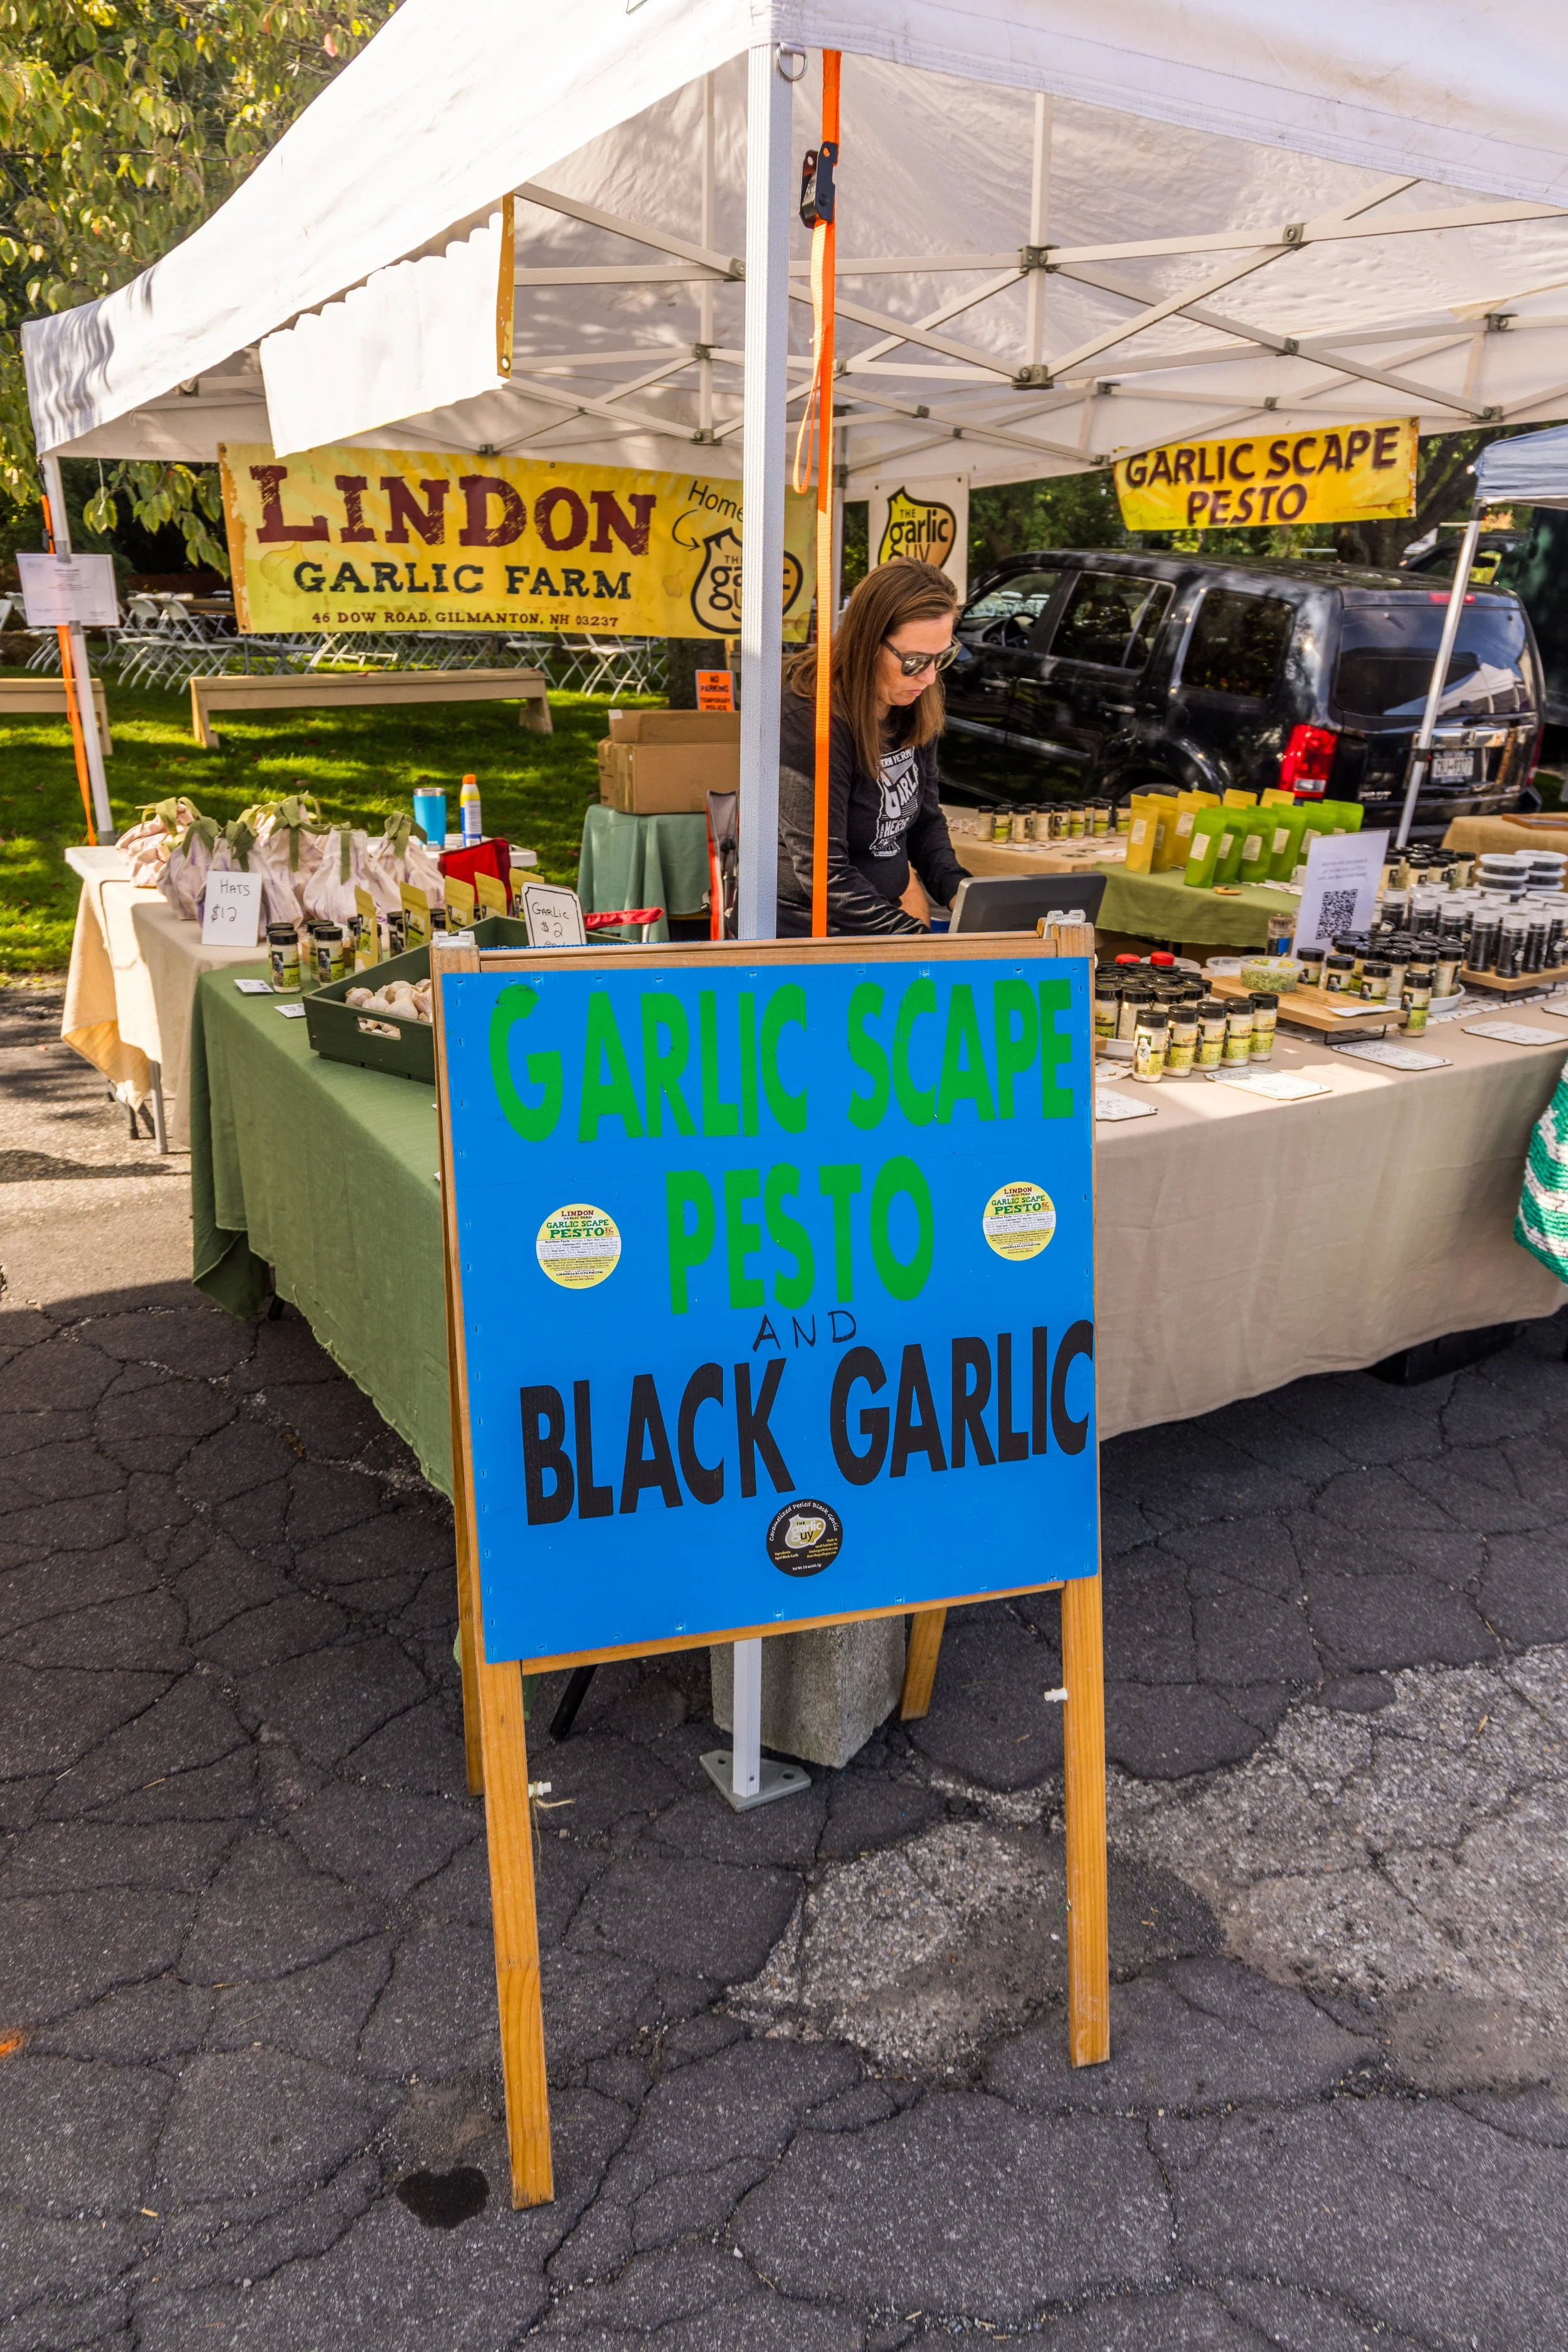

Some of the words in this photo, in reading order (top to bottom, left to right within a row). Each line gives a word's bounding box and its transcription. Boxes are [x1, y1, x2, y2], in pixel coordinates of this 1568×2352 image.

[1125, 443, 1255, 488] GARLIC
[1266, 426, 1400, 481] SCAPE
[249, 463, 657, 556] LINDON
[899, 508, 916, 518] THE
[1187, 483, 1308, 526] PESTO
[890, 509, 949, 548] garlic
[294, 561, 484, 593] GARLIC
[505, 565, 632, 600] FARM
[312, 612, 330, 623] 46
[337, 612, 376, 622] DOW
[384, 612, 431, 624] ROAD,
[435, 612, 544, 625] GILMANTON,
[549, 614, 569, 625] NH
[576, 615, 618, 627] 03237
[710, 675, 719, 683] NO
[220, 879, 250, 896] HATS
[211, 904, 237, 923] $12
[553, 922, 563, 937] 2
[489, 983, 808, 1142] GARLIC
[847, 977, 1075, 1131] SCAPE
[995, 1203, 1041, 1215] PESTO
[550, 1227, 605, 1238] PESTO
[665, 1155, 934, 1315] PESTO
[752, 1310, 857, 1353] AND
[520, 1356, 796, 1526] BLACK
[829, 1319, 1095, 1487] GARLIC
[791, 1520, 822, 1536] garlic
[813, 1502, 829, 1515] Black
[828, 1513, 839, 1531] Garlic
